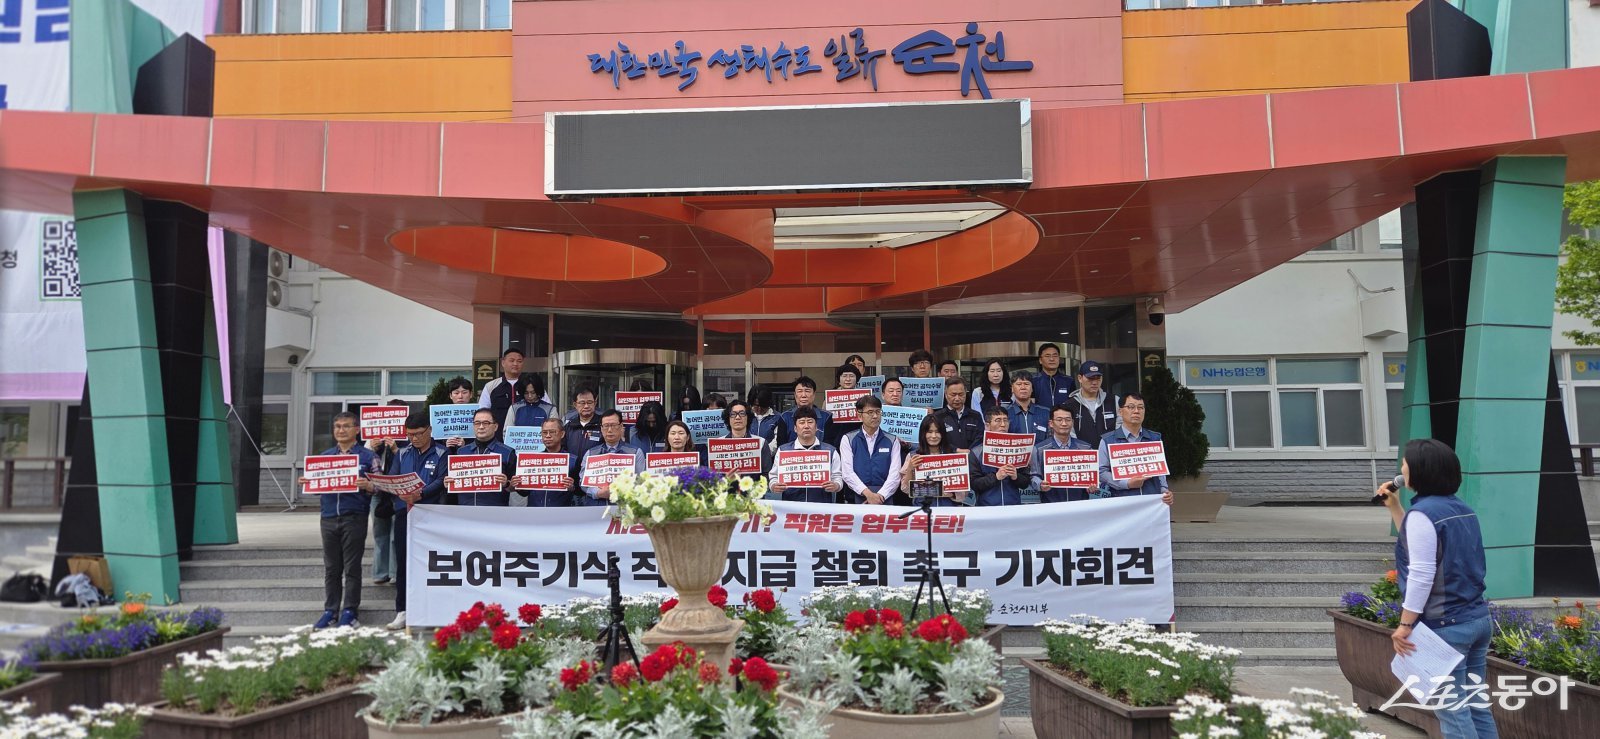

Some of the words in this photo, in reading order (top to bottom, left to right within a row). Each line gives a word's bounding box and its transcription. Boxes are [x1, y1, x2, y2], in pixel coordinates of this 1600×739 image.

[587, 41, 702, 91] 대한민국
[708, 41, 823, 83] 생태수도
[824, 28, 886, 92] 일류
[892, 22, 1034, 100] 순천
[1202, 367, 1266, 378] NH농협은행
[362, 410, 383, 419] 살인적인
[383, 409, 406, 417] 업무폭탄
[365, 425, 404, 437] 철회하라!
[711, 444, 734, 452] 살인적인
[735, 442, 758, 450] 업무폭탄
[986, 437, 1010, 445] 살인적인
[1011, 437, 1033, 445] 업무폭탄
[1111, 449, 1136, 458] 살인적인
[1136, 445, 1160, 455] 업무폭탄
[308, 461, 331, 470] 살인적인
[332, 458, 356, 467] 업무폭탄
[451, 461, 474, 470] 살인적인
[475, 458, 499, 467] 업무폭탄
[519, 458, 542, 466] 살인적인
[543, 457, 567, 465] 업무폭탄
[588, 460, 609, 468] 살인적인
[609, 458, 633, 466] 업무폭탄
[673, 456, 697, 465] 업무폭탄
[713, 458, 757, 470] 철회하라!
[781, 456, 804, 464] 살인적인
[805, 454, 828, 462] 업무폭탄
[943, 457, 966, 467] 업무폭탄
[987, 453, 1028, 465] 철회하라!
[1047, 456, 1071, 464] 살인적인
[1117, 461, 1163, 476] 철회하라!
[309, 475, 354, 489] 철회하라!
[454, 476, 497, 489] 철회하라!
[521, 474, 564, 485] 철회하라!
[588, 474, 614, 484] 철회하
[783, 471, 826, 483] 철회하라!
[1050, 472, 1095, 483] 철회하라!
[783, 513, 855, 534] 직원은
[860, 514, 966, 534] 업무폭탄!
[426, 550, 617, 588] 보여주기식
[721, 550, 797, 588] 지급
[812, 549, 888, 588] 철회
[903, 549, 981, 588] 촉구
[994, 546, 1155, 587] 기자회견
[998, 603, 1050, 615] 순천시지부
